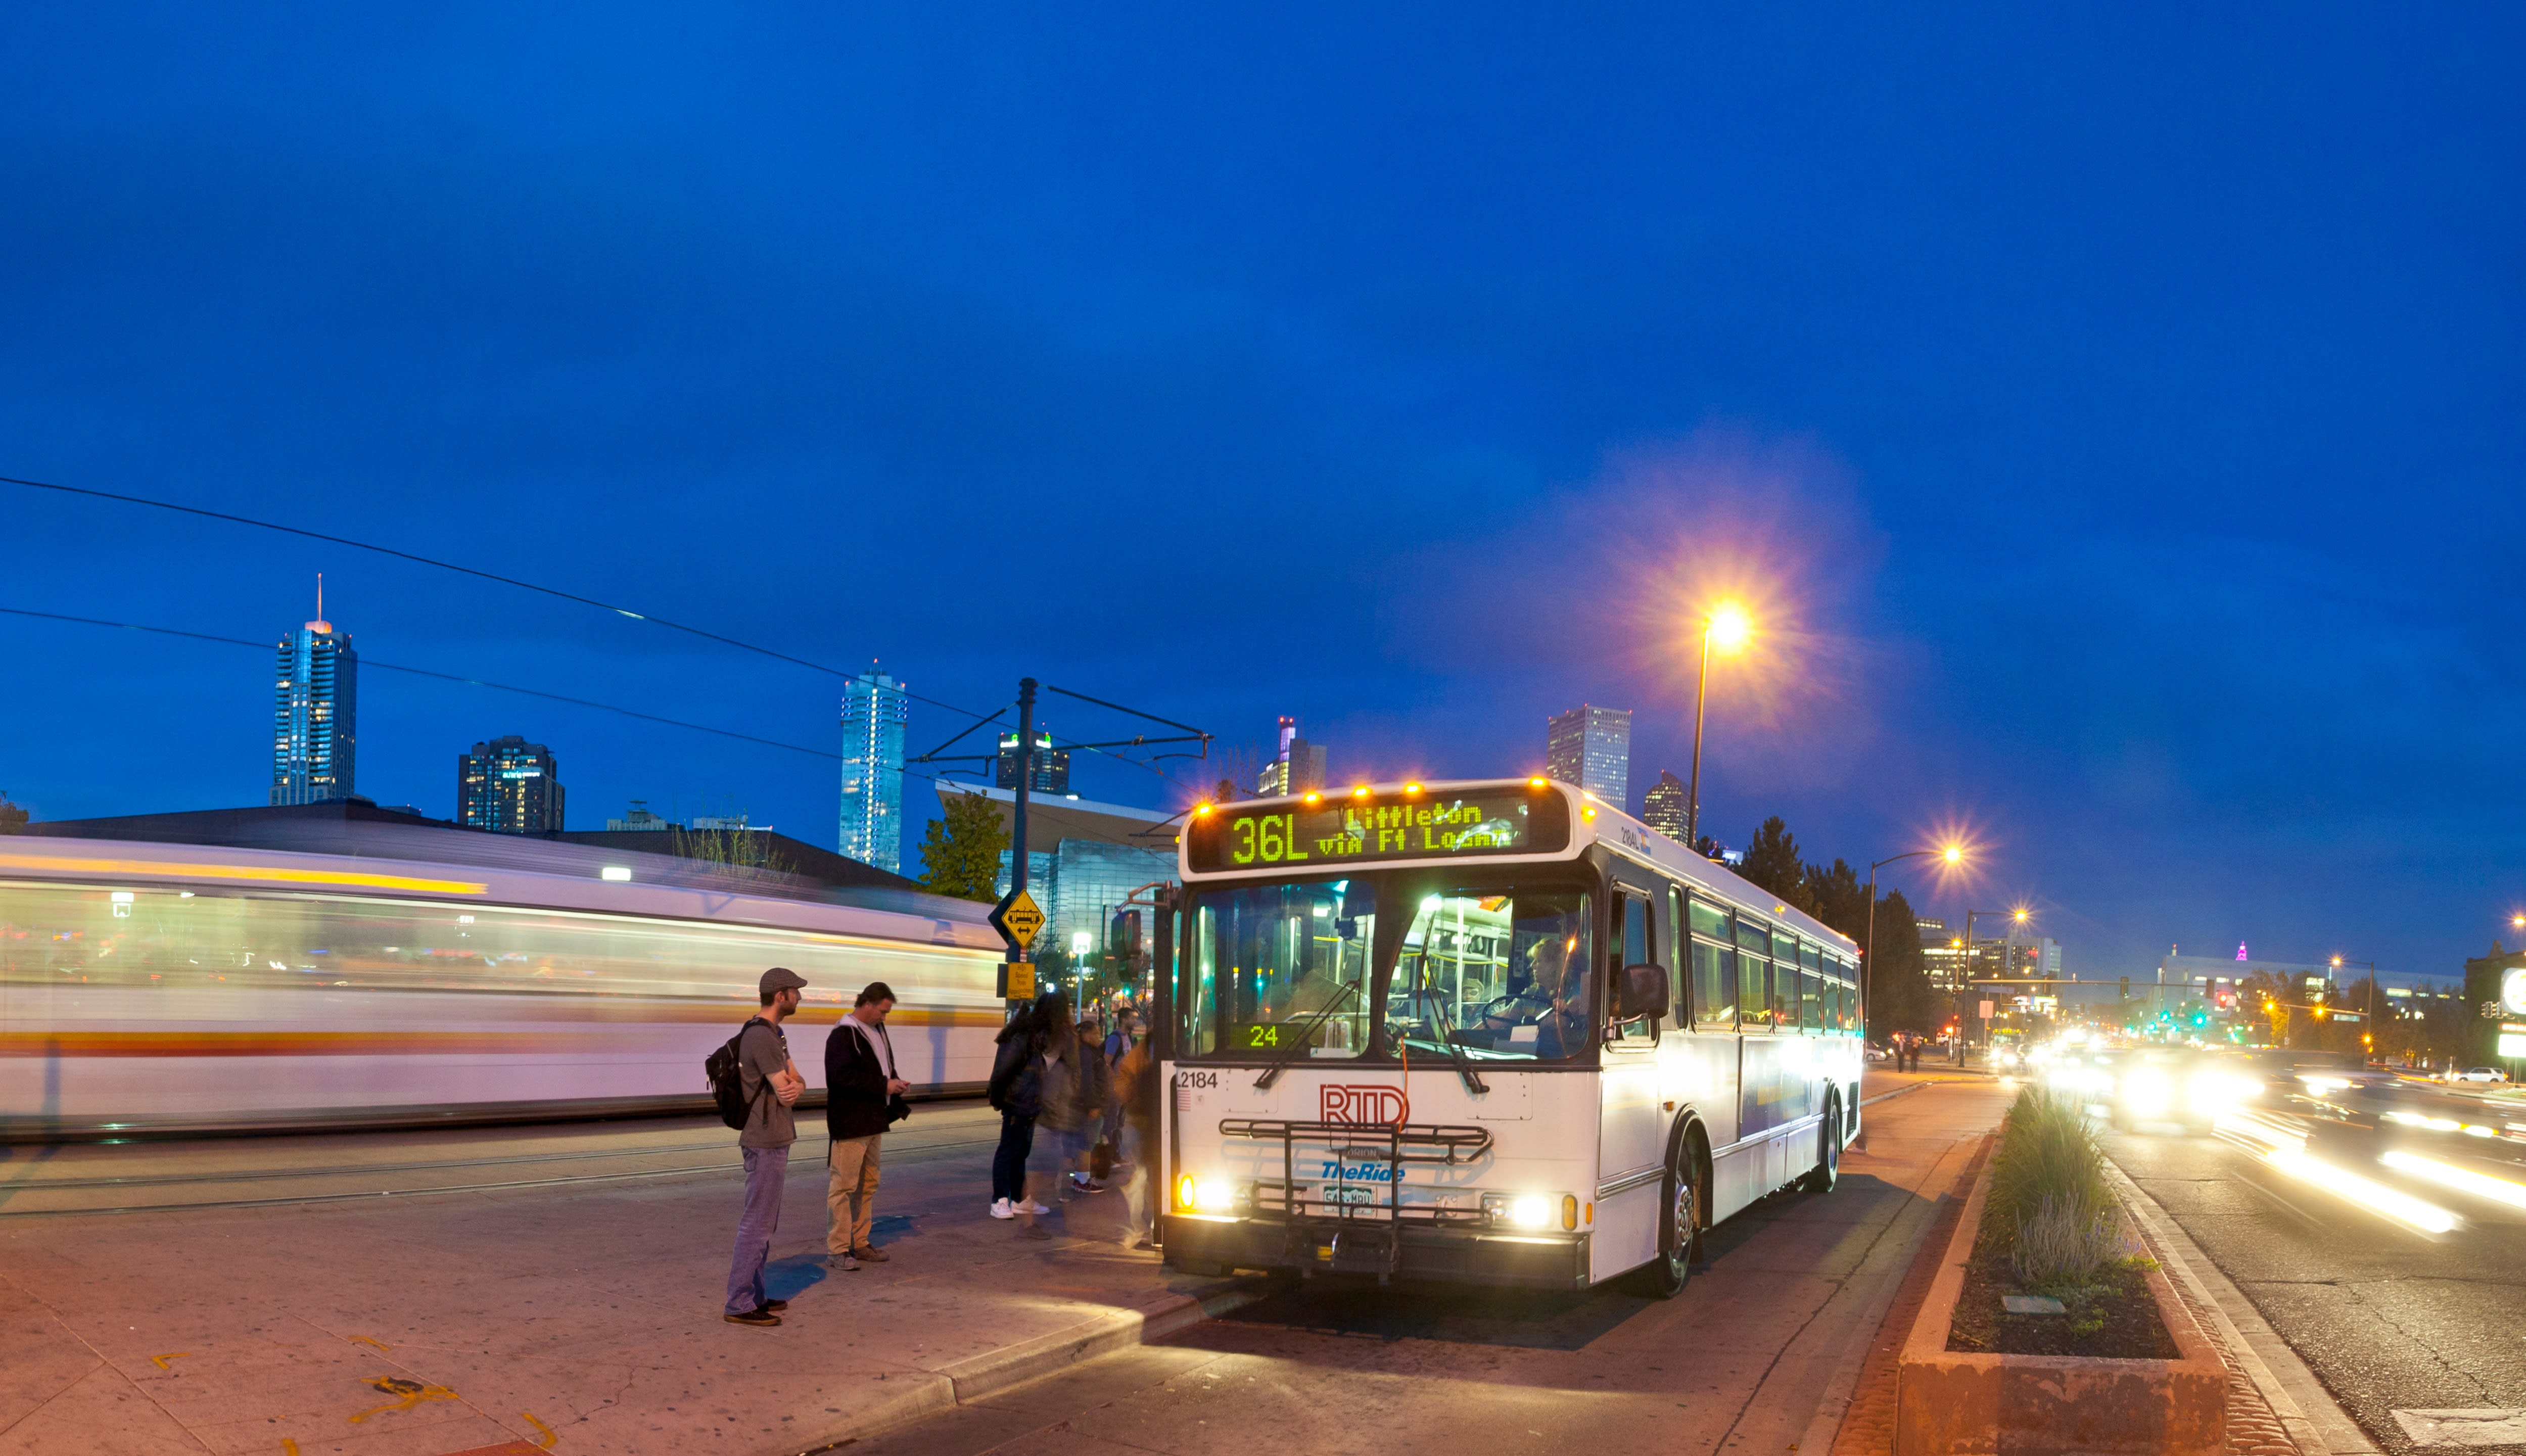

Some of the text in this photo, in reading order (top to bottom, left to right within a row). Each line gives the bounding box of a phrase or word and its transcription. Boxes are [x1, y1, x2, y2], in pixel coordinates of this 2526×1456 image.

[1347, 803, 1481, 829] Littleton
[1234, 814, 1308, 864] 36L
[1320, 833, 1362, 855] via
[1379, 829, 1406, 852] Ft
[1250, 1025, 1278, 1046] 24
[1177, 1071, 1218, 1088] 2184
[1320, 1084, 1410, 1130] RTD
[1347, 1148, 1377, 1157] ORION
[1322, 1161, 1406, 1183] TheRide
